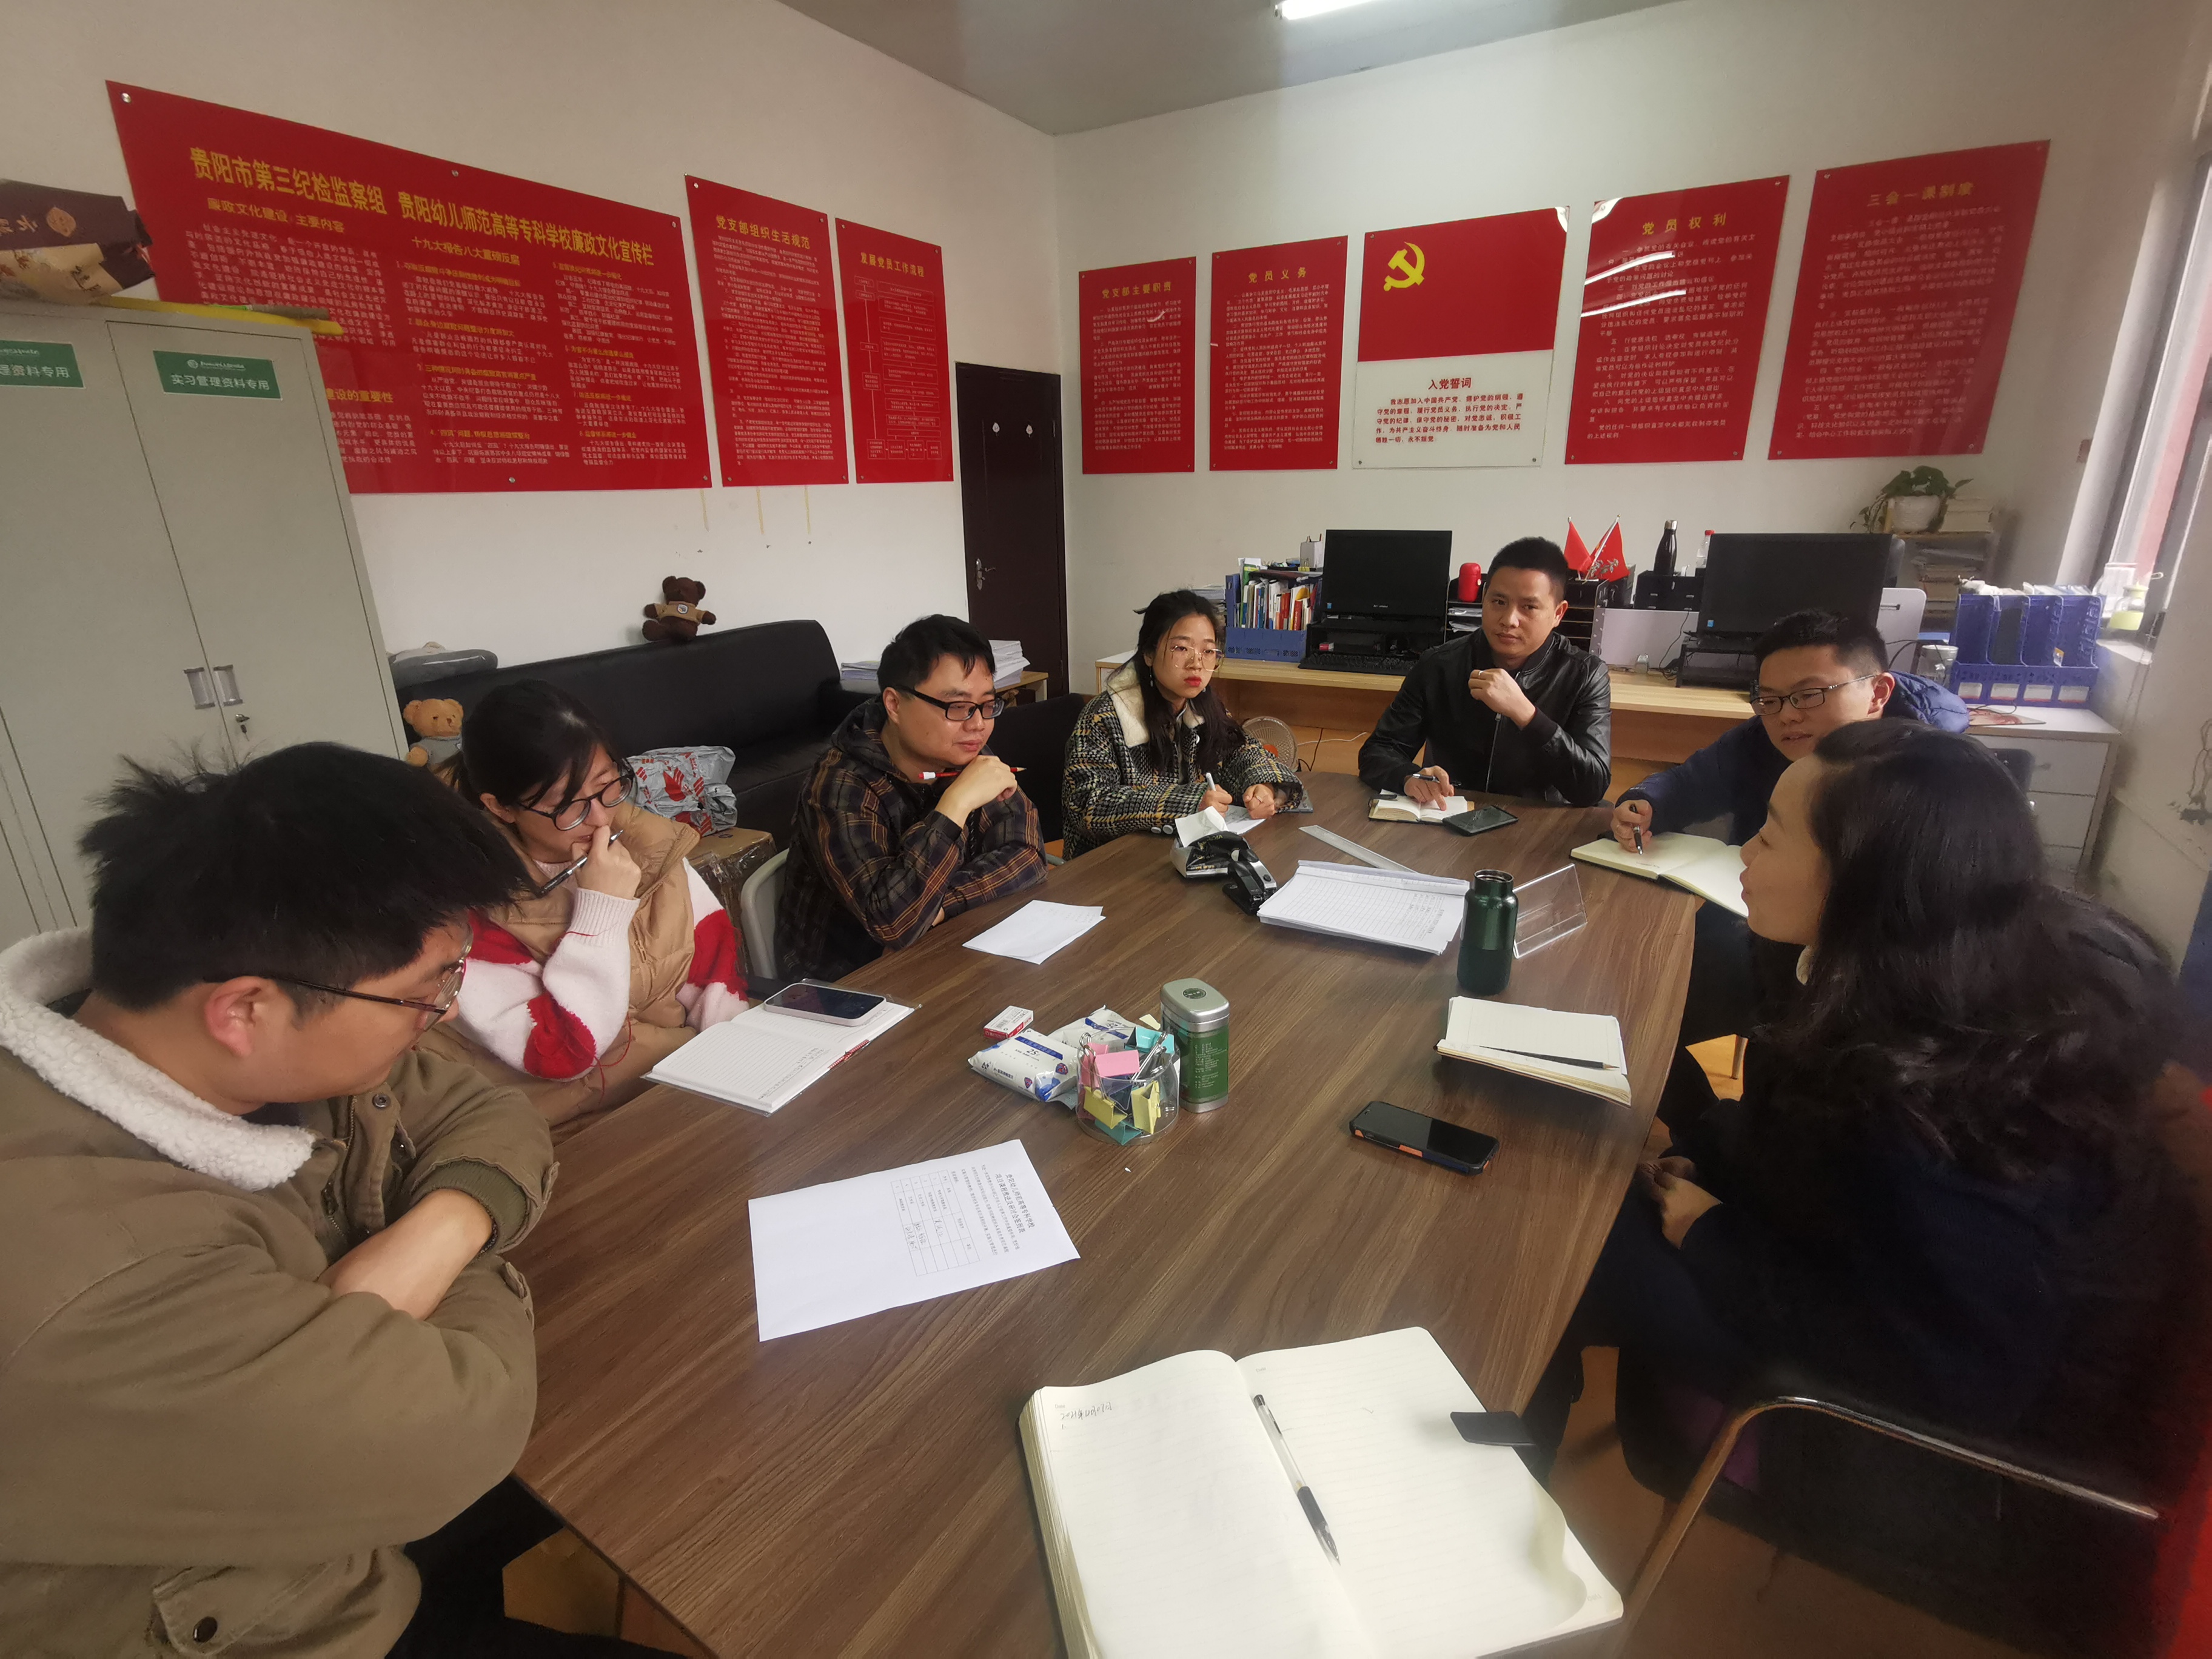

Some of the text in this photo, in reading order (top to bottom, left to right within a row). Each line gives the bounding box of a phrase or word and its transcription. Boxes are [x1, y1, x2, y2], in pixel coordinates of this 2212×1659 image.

[190, 147, 654, 267] 贵阳市第三纪检监察组 贵阳幼儿师范高等专科学校廉政文化宣传栏
[296, 215, 344, 233] 主要内容
[716, 214, 811, 250] 党支部组织生活规范
[1642, 212, 1727, 235] 党员权利
[860, 252, 925, 278] 发展党员工作流程
[1248, 267, 1307, 283] 党员义务
[1101, 281, 1171, 299] 党支部主要职责
[170, 374, 270, 390] 实习管理资料专用
[1428, 377, 1472, 390] 入党誓词
